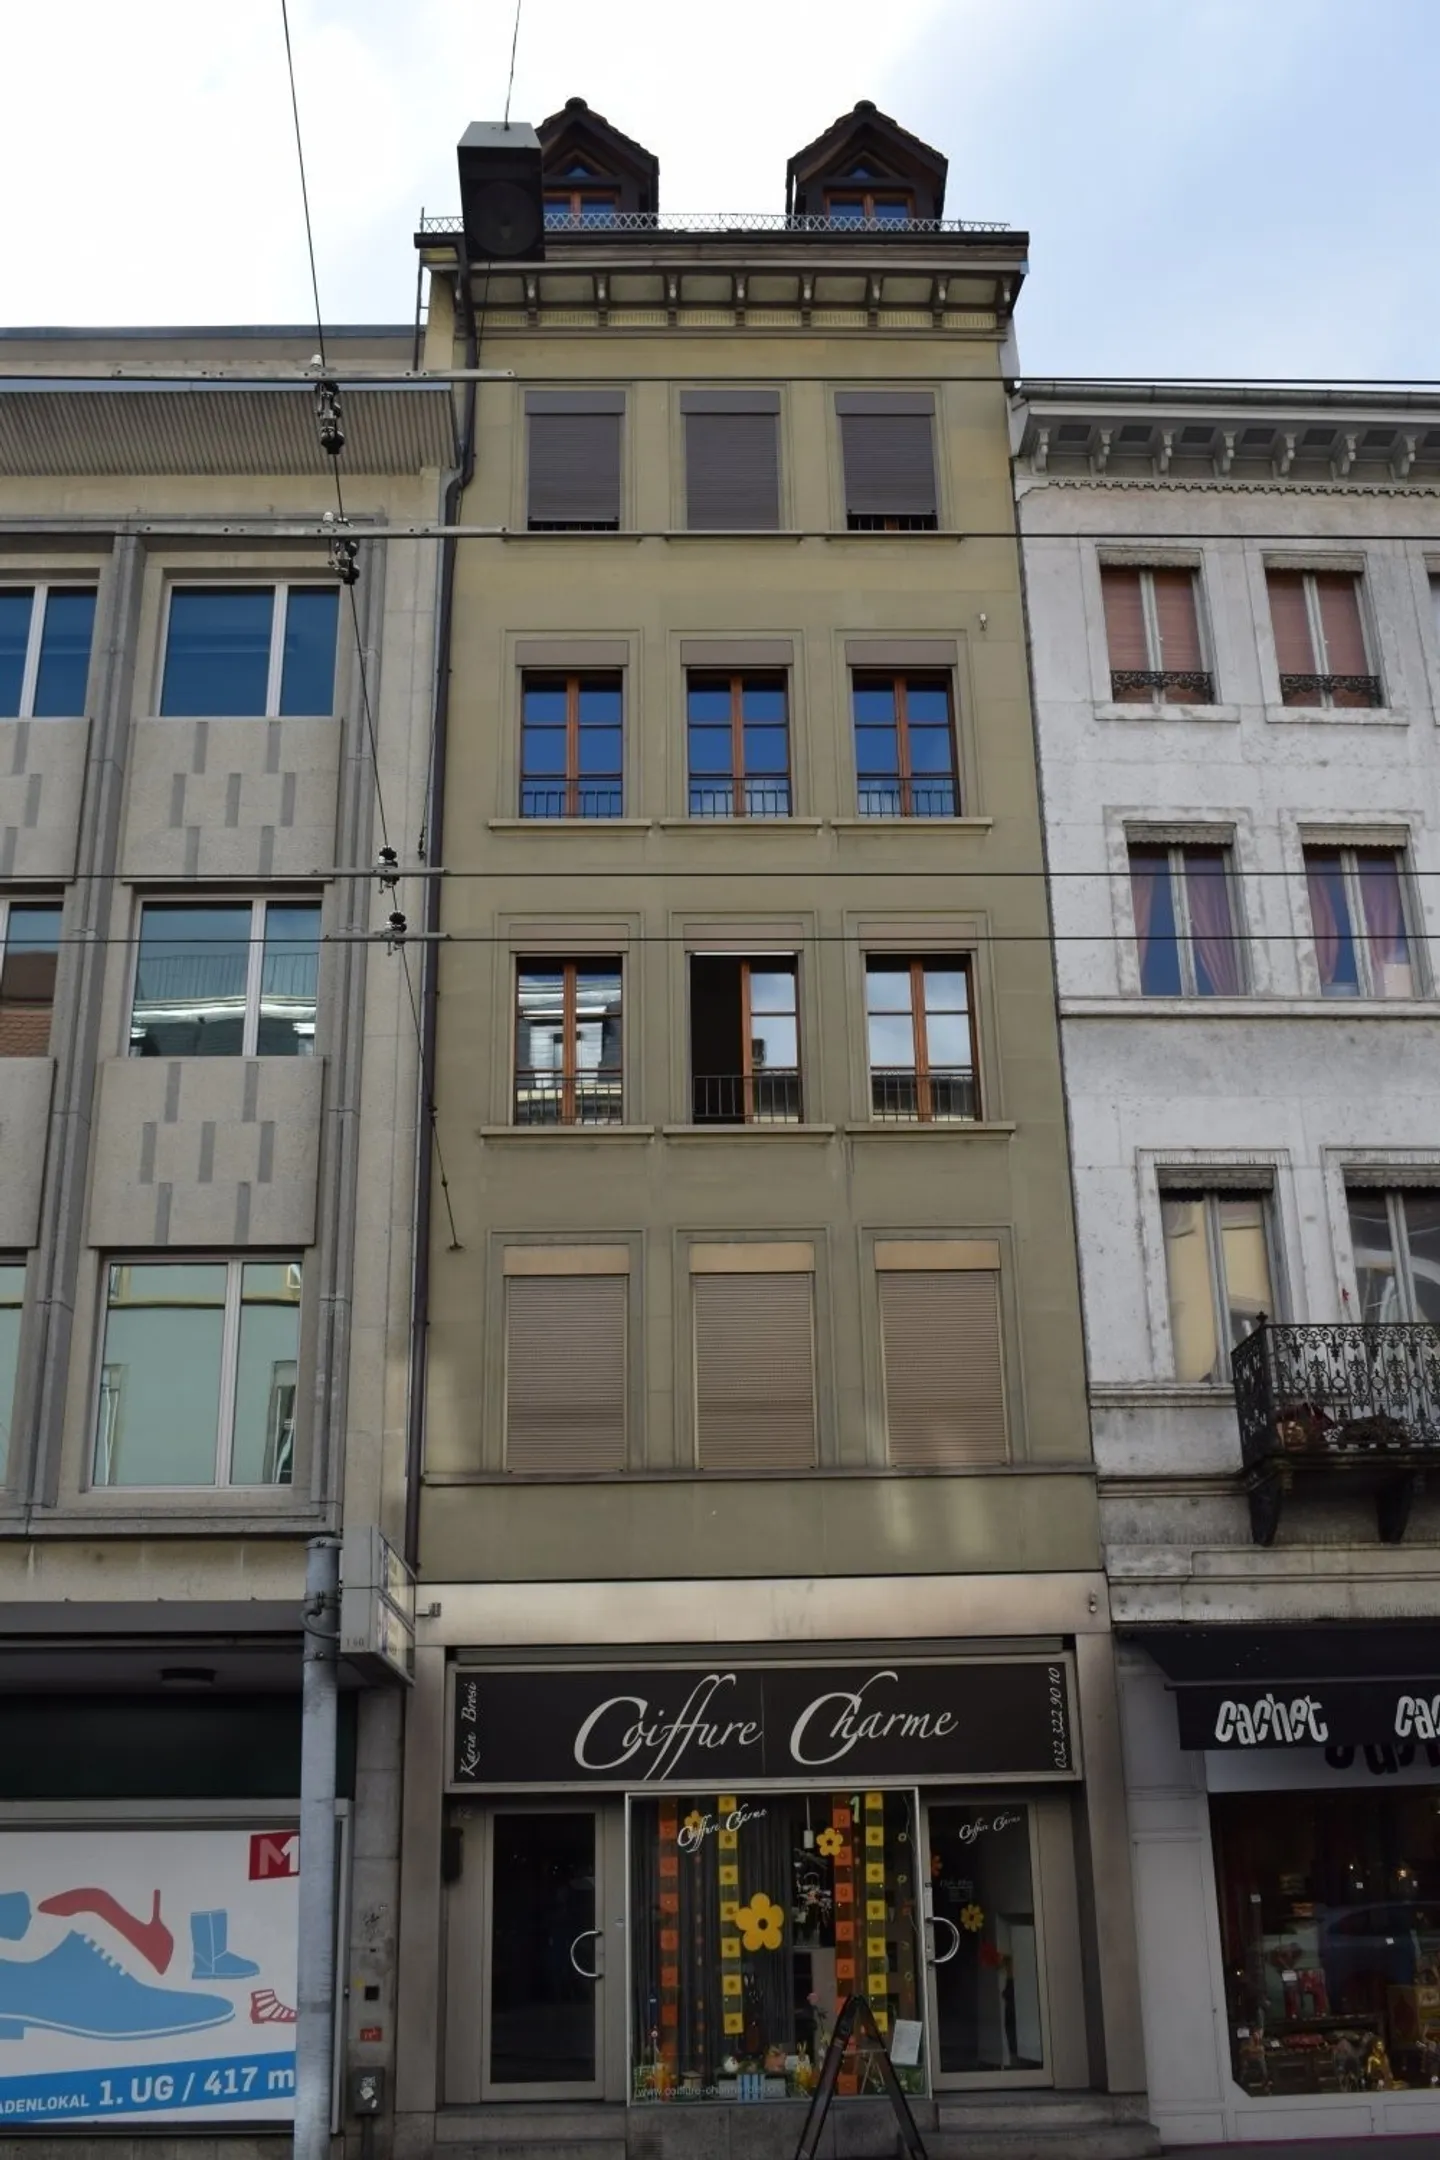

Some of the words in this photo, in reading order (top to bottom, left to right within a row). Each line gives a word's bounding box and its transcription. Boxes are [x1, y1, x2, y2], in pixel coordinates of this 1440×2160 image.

[1048, 1667, 1060, 1684] 10
[1049, 1686, 1062, 1708] 90
[573, 1673, 763, 1781] Coiffure
[790, 1671, 958, 1765] Charme
[1215, 1693, 1329, 1744] cachet
[100, 2081, 124, 2106] 1.
[131, 2075, 175, 2104] UG
[204, 2067, 258, 2096] 417
